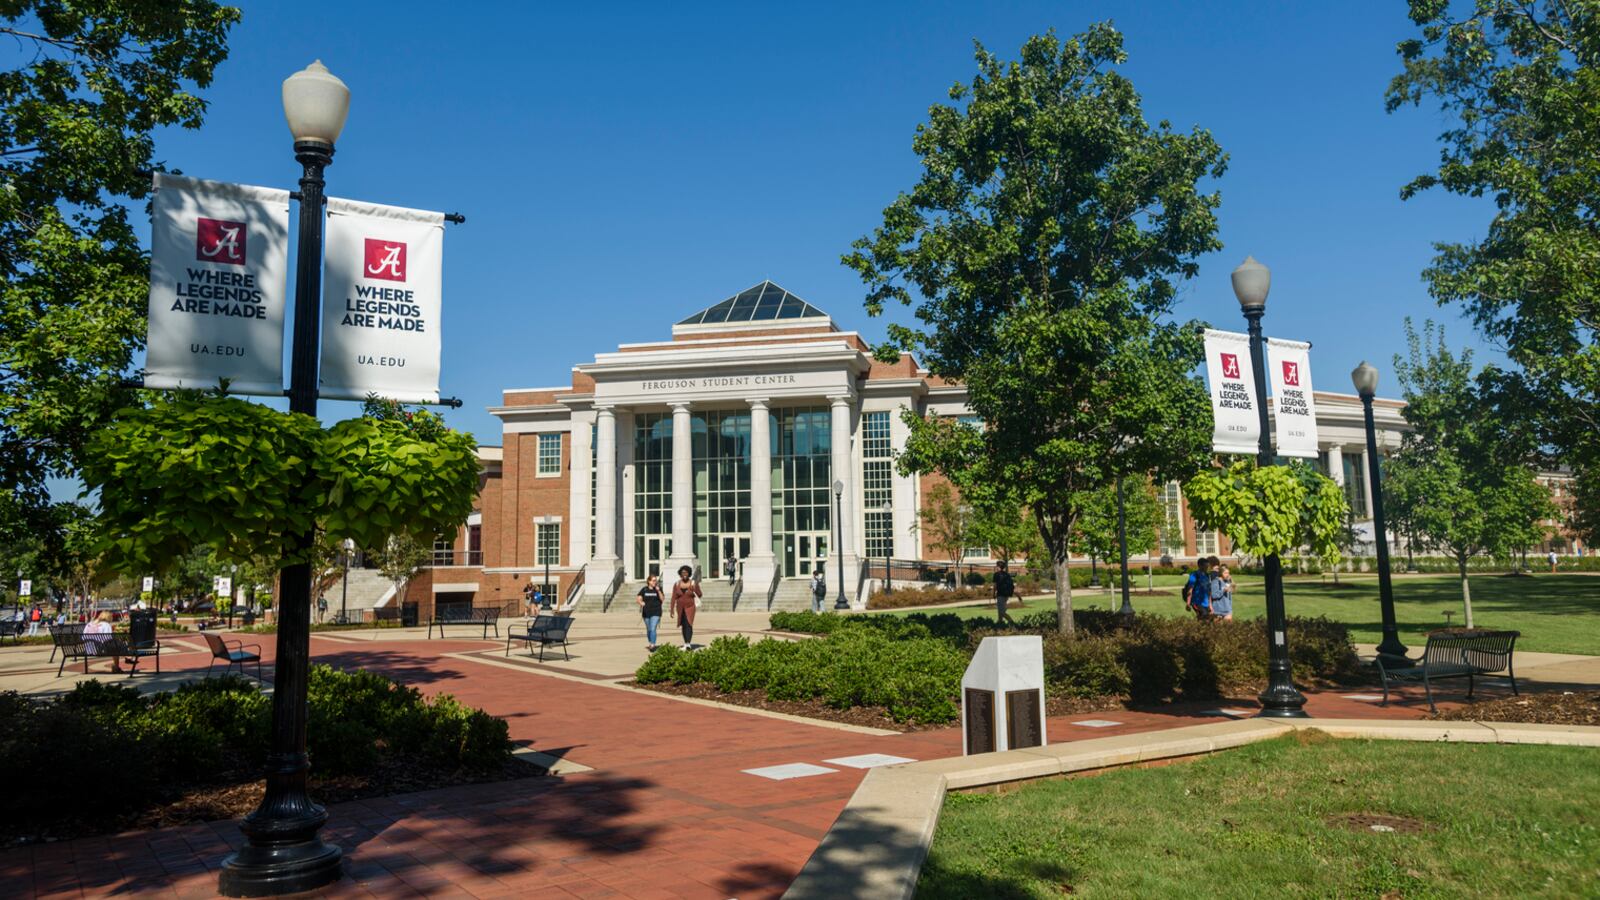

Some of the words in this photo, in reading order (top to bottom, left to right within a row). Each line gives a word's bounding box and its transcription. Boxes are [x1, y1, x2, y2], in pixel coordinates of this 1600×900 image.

[202, 225, 241, 259] A
[368, 245, 402, 277] A
[187, 268, 254, 288] WHERE
[176, 283, 262, 304] LEGENDS
[355, 285, 414, 303] WHERE
[171, 299, 209, 314] ARE
[213, 303, 266, 320] MADE
[346, 299, 420, 318] LEGENDS
[341, 314, 375, 328] ARE
[378, 318, 425, 332] MADE
[191, 344, 245, 357] UA.EDU
[358, 355, 405, 367] UA.EDU
[642, 380, 696, 390] FERGUSON
[703, 377, 749, 387] STUDENT
[755, 375, 796, 384] CENTER
[1222, 382, 1245, 392] WHERE
[1220, 390, 1249, 401] LEGENDS
[1283, 389, 1304, 399] WHERE
[1220, 400, 1233, 408] ARE
[1234, 402, 1252, 410] MADE
[1280, 398, 1307, 407] LEGENDS
[1280, 407, 1292, 415] ARE
[1293, 408, 1310, 416] MADE
